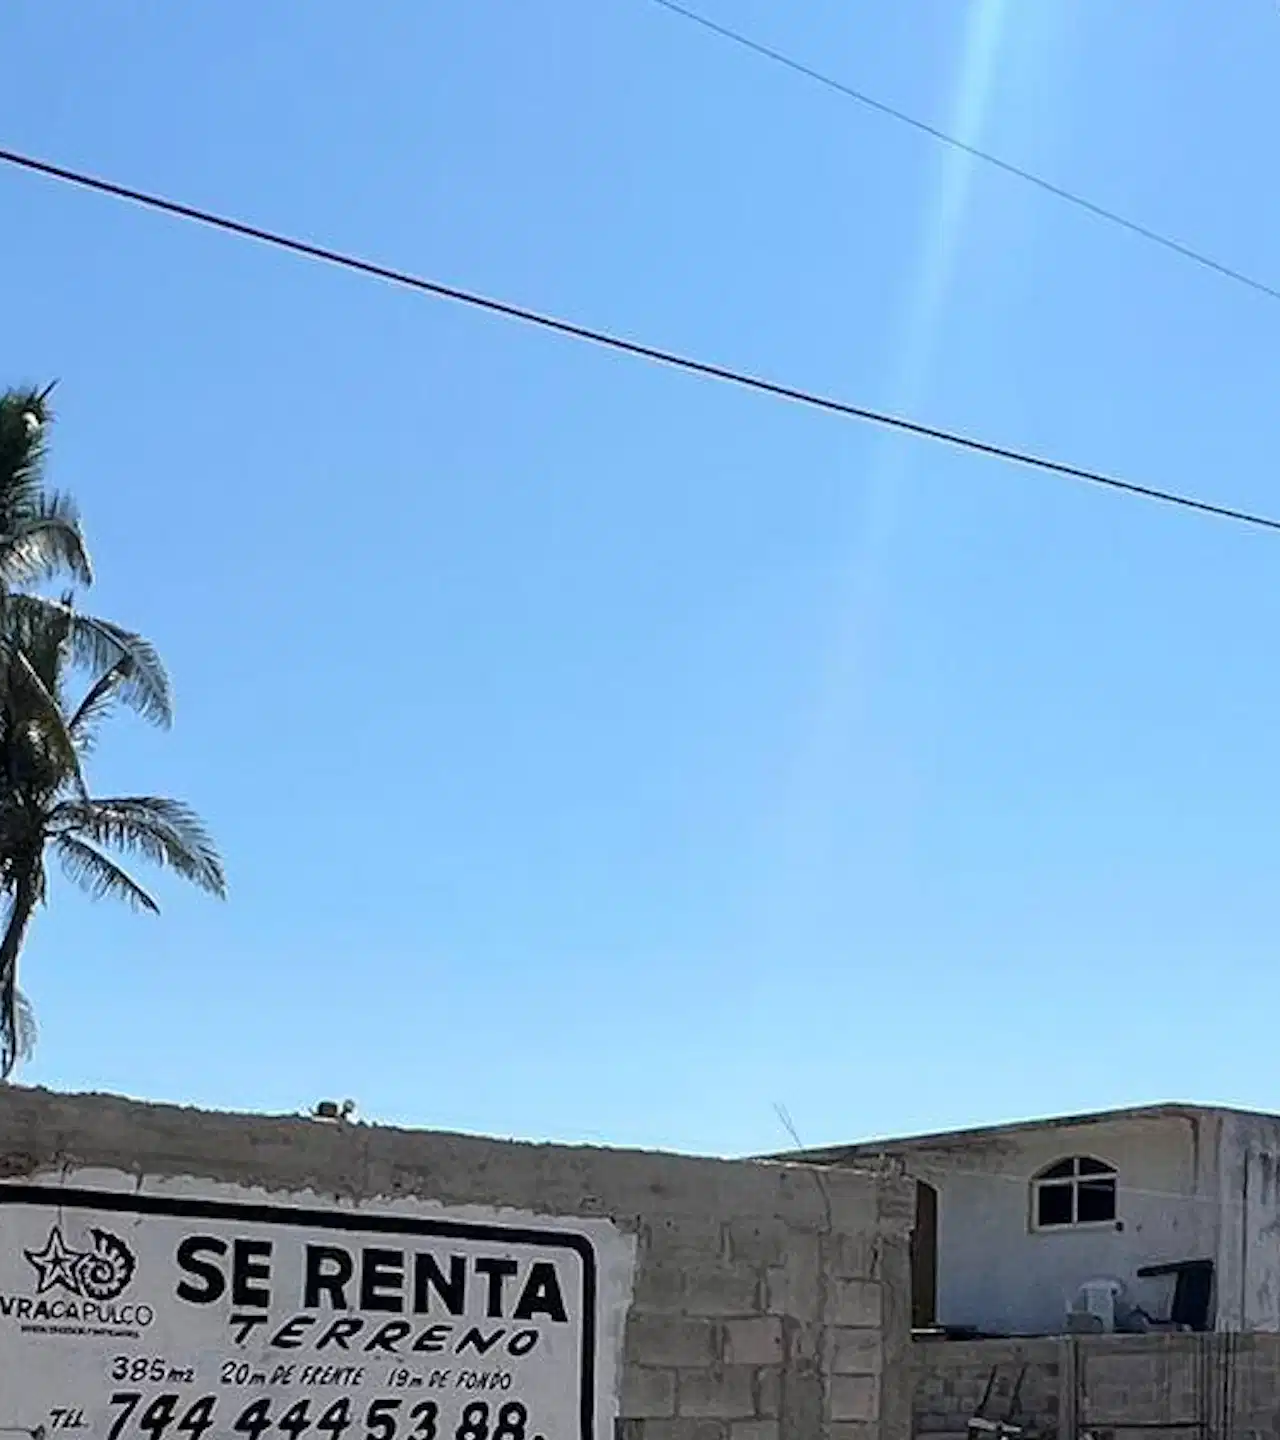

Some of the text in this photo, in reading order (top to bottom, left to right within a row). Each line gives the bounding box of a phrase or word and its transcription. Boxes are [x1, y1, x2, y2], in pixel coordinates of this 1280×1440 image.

[176, 1236, 569, 1323] SE RENTA
[230, 1314, 540, 1356] TERRENO
[270, 1365, 297, 1386] DE
[299, 1365, 365, 1386] FRENTE
[428, 1369, 451, 1389] DE
[456, 1371, 512, 1391] FONDO
